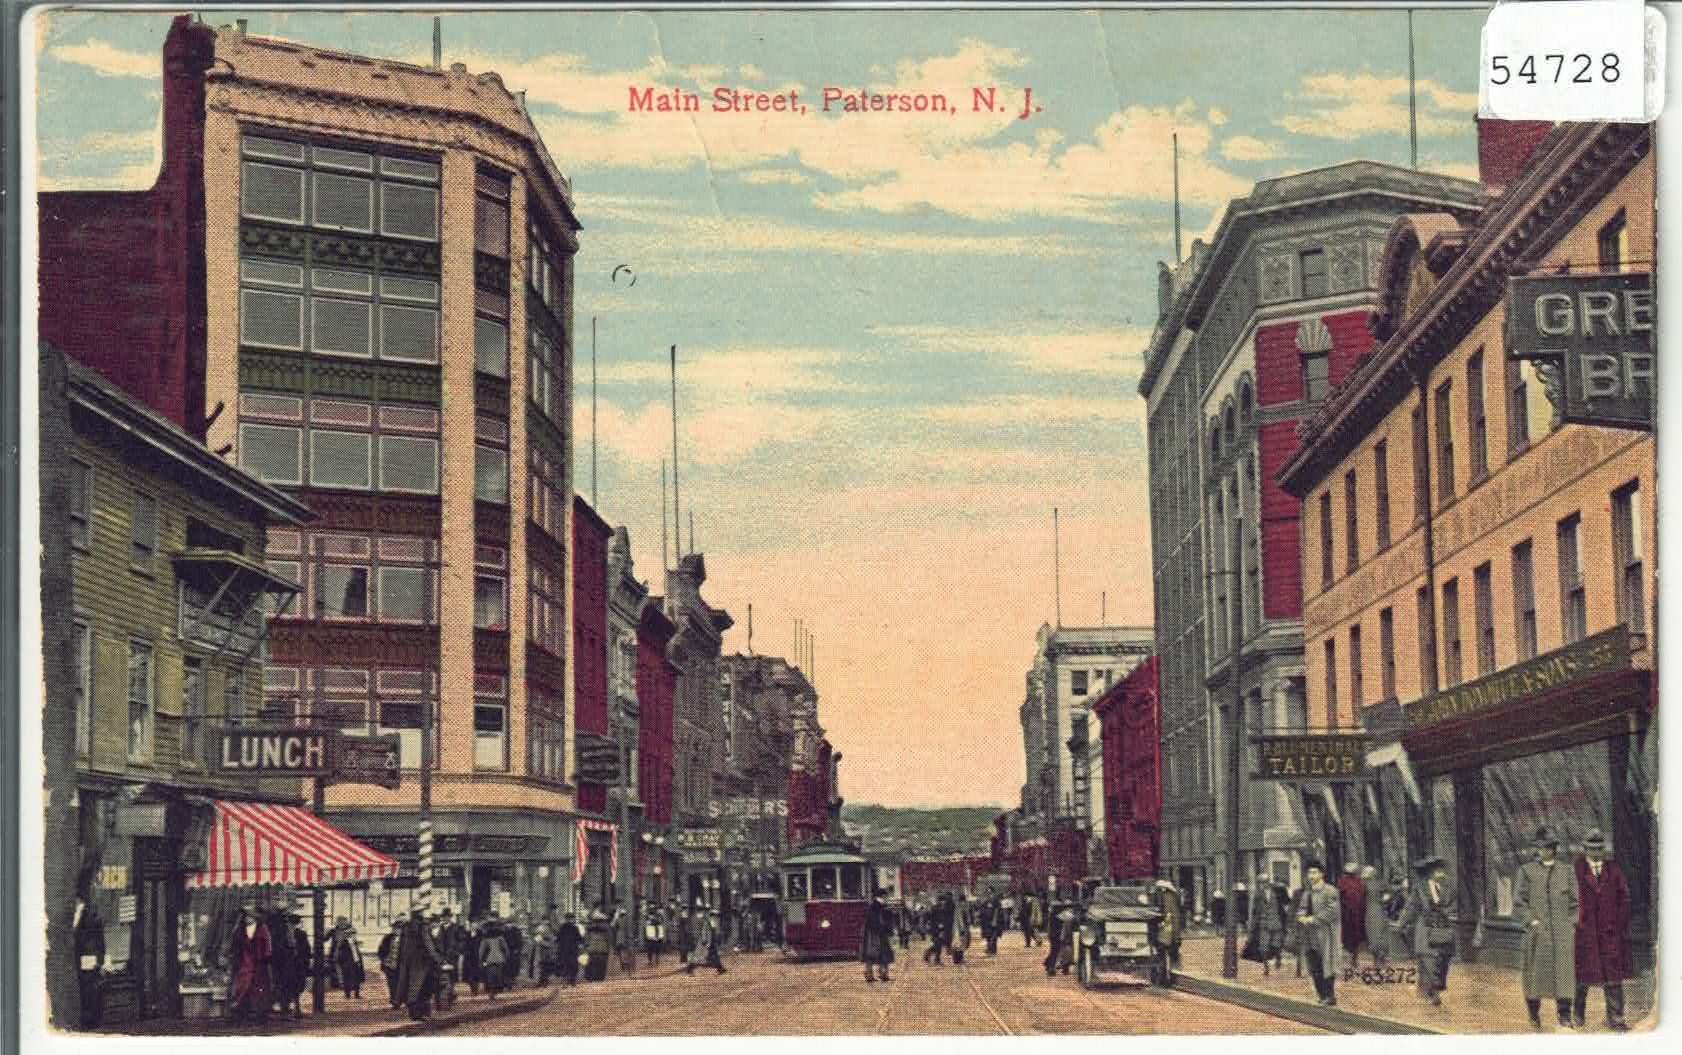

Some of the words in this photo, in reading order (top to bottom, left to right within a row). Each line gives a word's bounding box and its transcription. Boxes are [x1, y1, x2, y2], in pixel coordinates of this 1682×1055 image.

[1490, 53, 1621, 85] 54728
[221, 735, 325, 769] LUNCH
[1269, 757, 1354, 775] TAILOR
